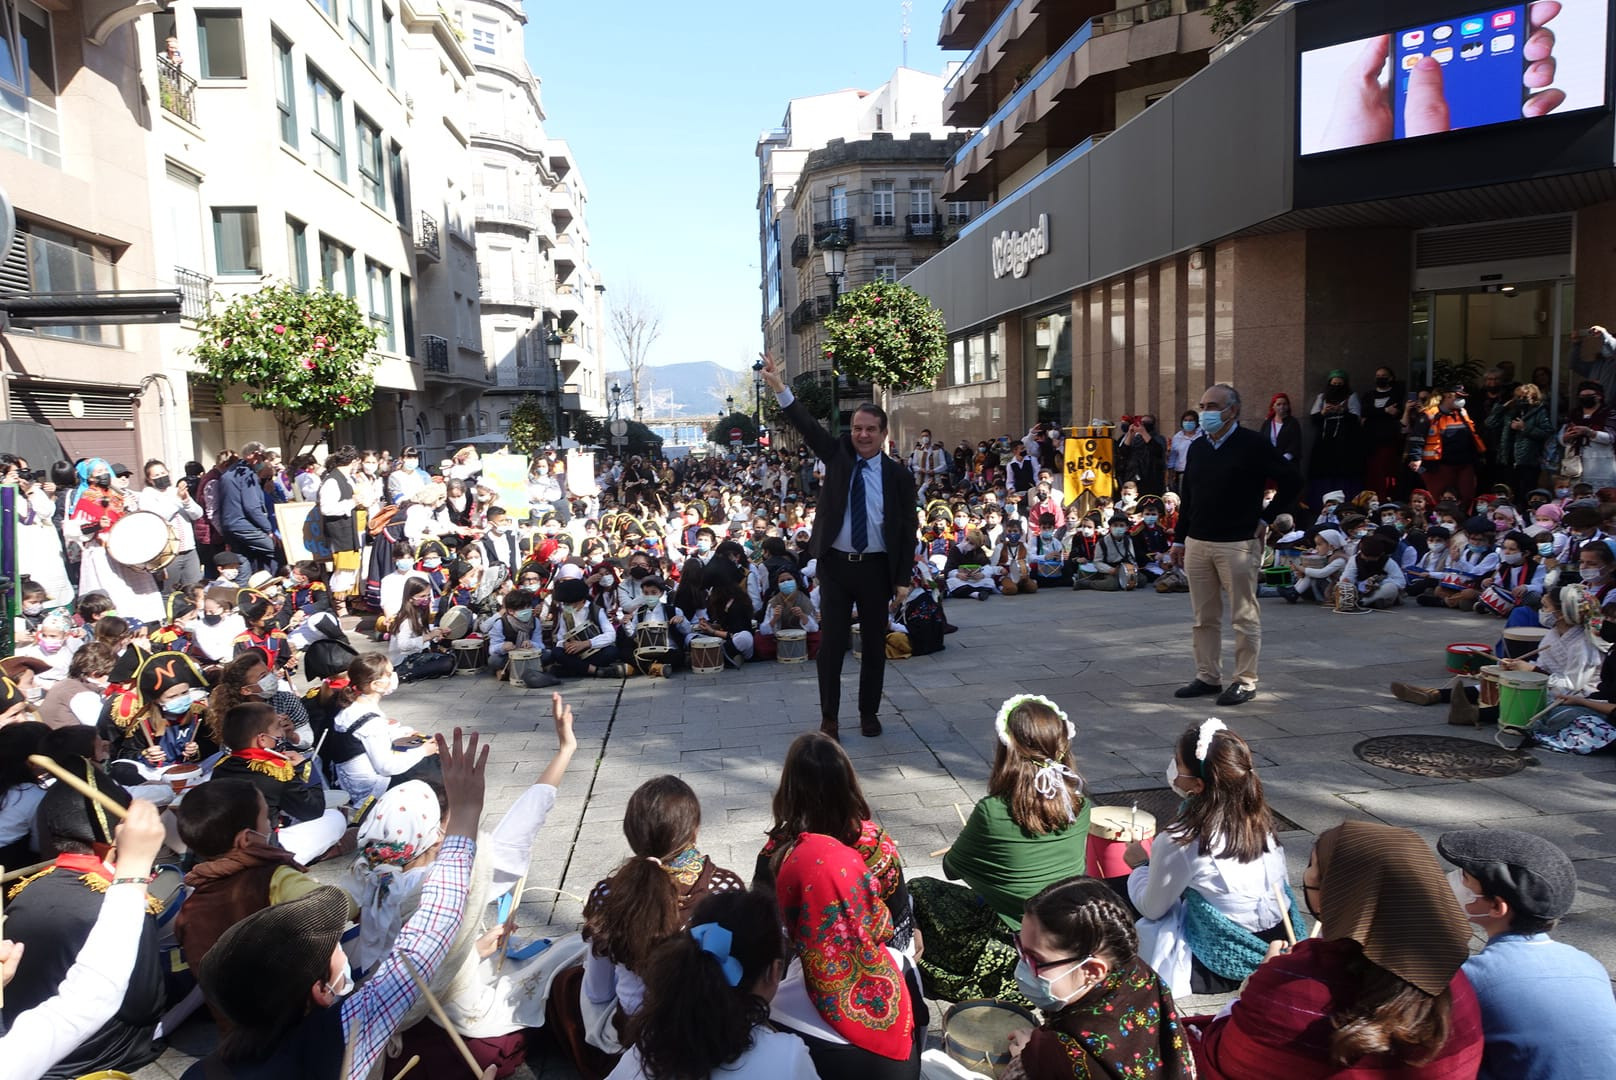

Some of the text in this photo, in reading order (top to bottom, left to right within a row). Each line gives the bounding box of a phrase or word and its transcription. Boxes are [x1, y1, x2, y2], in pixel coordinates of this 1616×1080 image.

[1085, 440, 1097, 452] O
[153, 659, 177, 691] N
[176, 727, 191, 740] N
